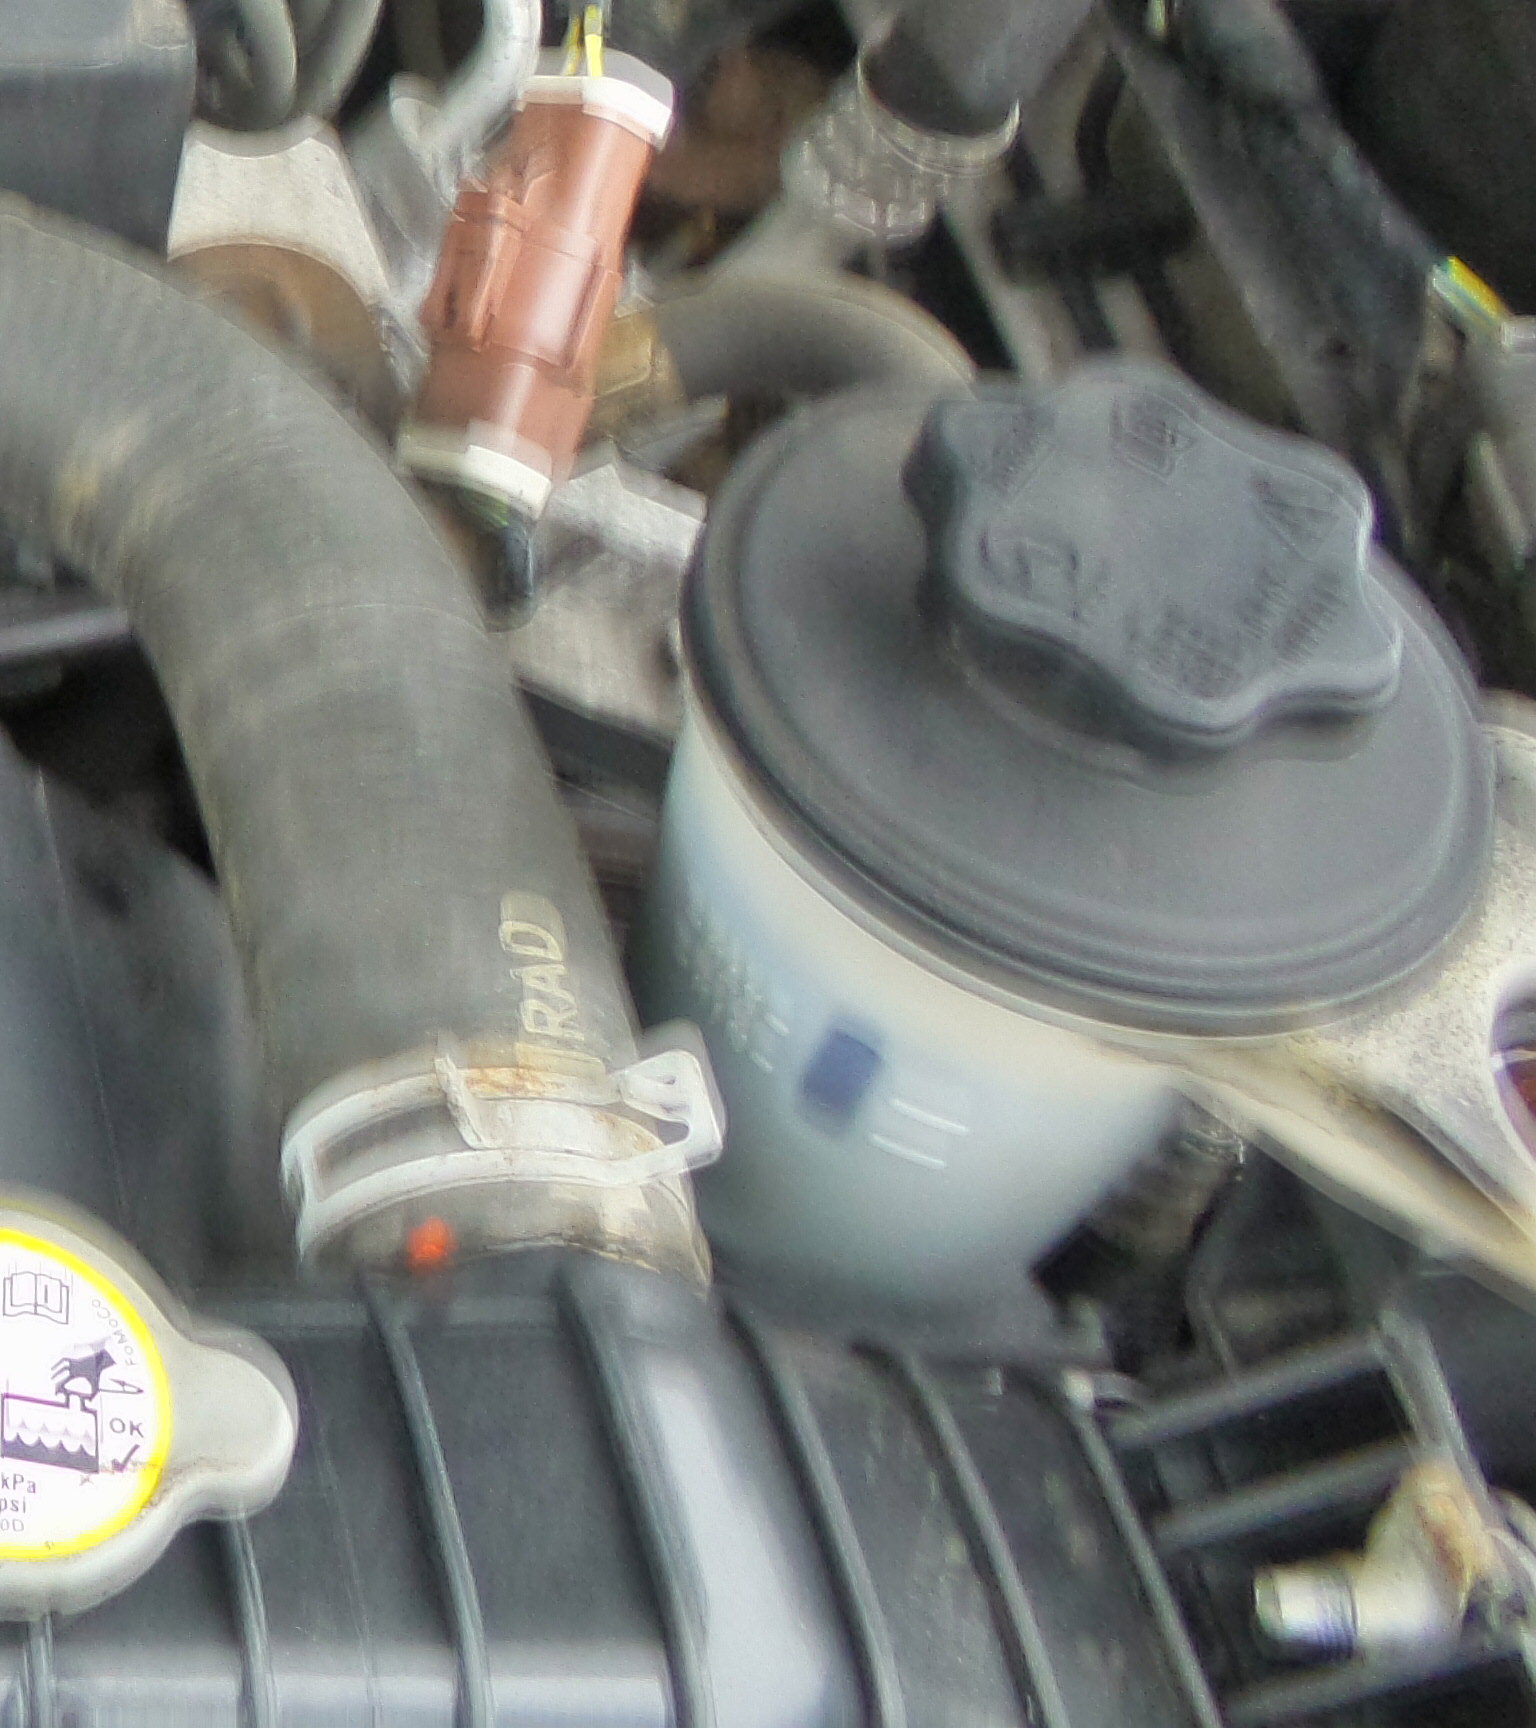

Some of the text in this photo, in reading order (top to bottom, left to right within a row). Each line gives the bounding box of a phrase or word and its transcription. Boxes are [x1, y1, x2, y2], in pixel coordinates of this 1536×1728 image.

[498, 919, 585, 1042] RAD
[109, 1417, 144, 1438] OK
[1, 1472, 36, 1494] kPa
